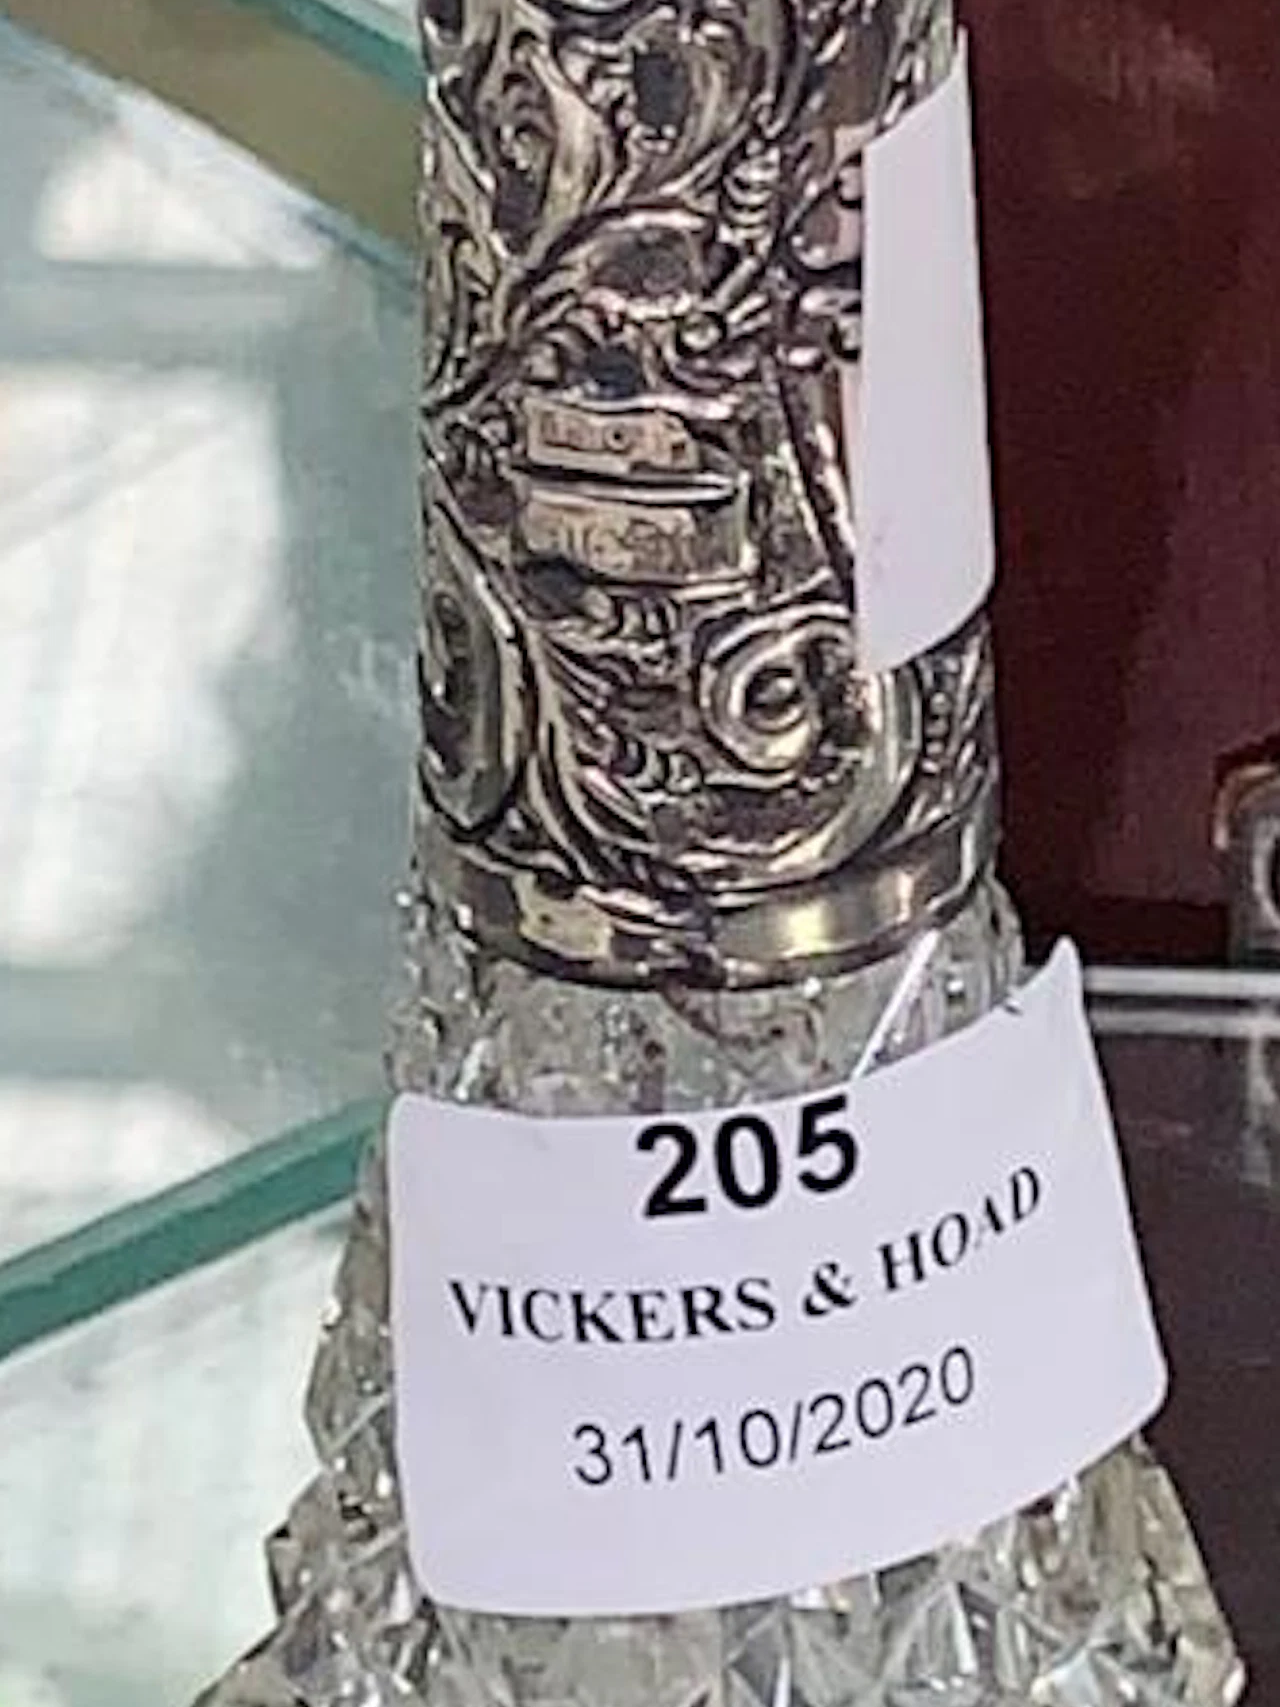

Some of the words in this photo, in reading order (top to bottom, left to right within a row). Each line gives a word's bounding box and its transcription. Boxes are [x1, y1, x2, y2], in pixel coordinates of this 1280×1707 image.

[634, 1092, 860, 1220] 205
[448, 1277, 777, 1345] VICKERS
[802, 1261, 856, 1318] &
[877, 1164, 1042, 1293] HOAD
[573, 1344, 976, 1487] 31/10/2020
